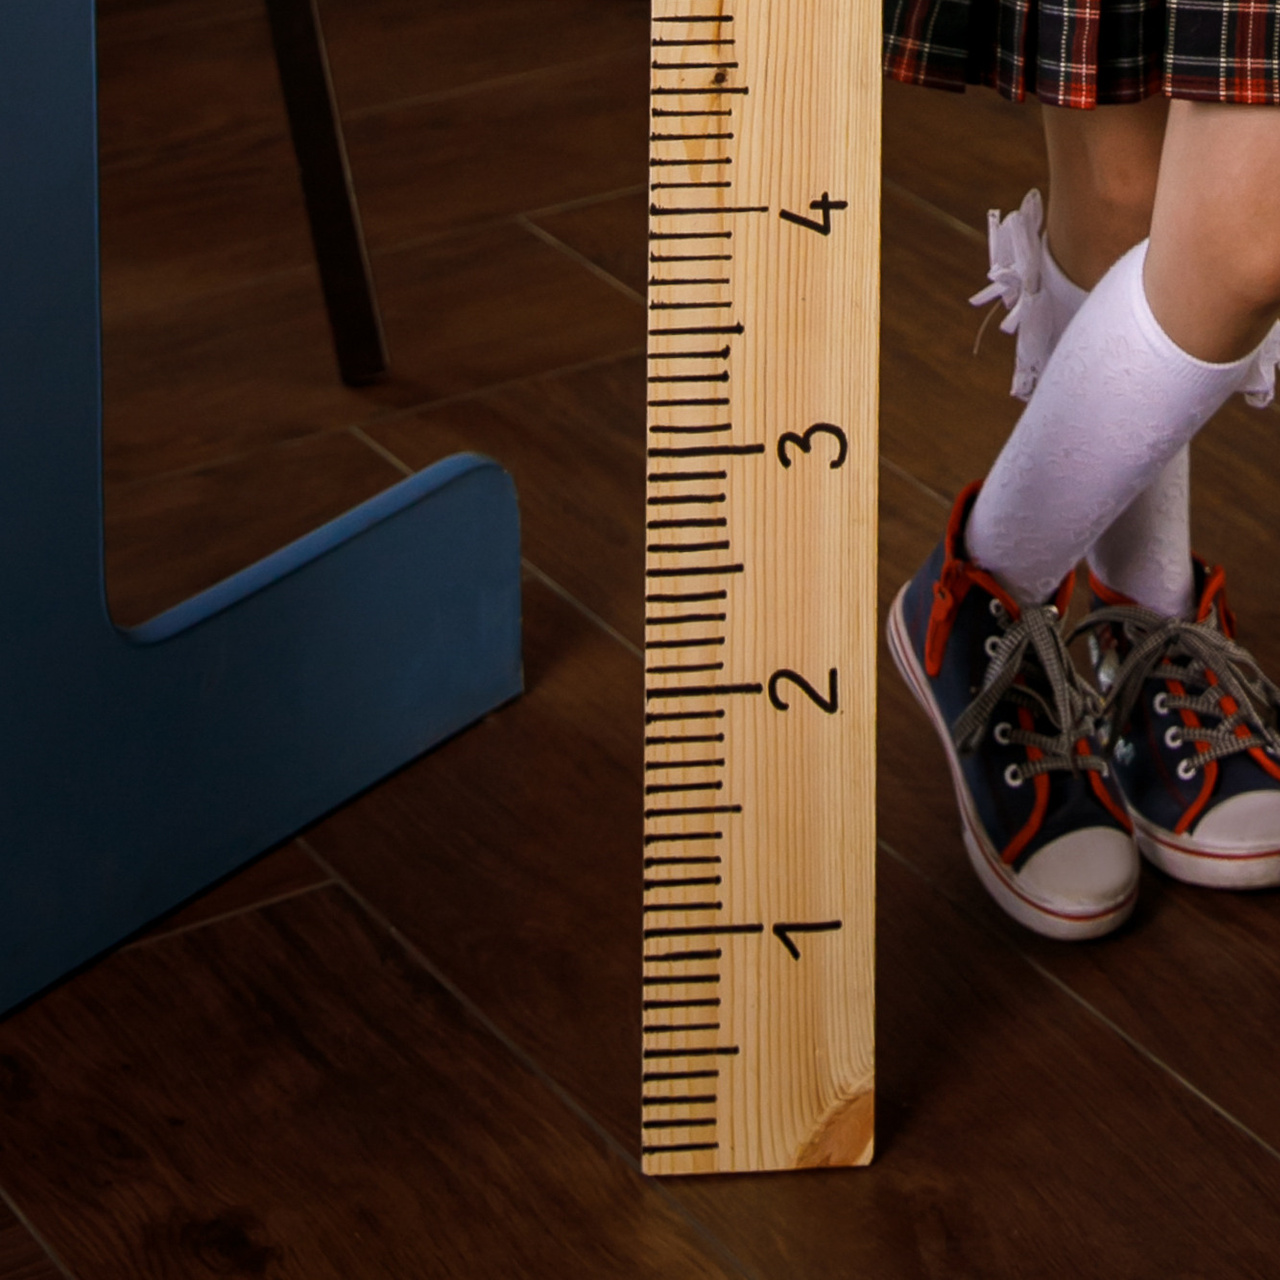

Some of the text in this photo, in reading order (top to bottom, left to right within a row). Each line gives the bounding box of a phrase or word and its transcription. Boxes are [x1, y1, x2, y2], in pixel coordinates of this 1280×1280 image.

[778, 191, 849, 237] 4
[776, 422, 848, 469] 3
[767, 667, 839, 715] 2
[772, 919, 843, 962] 1
